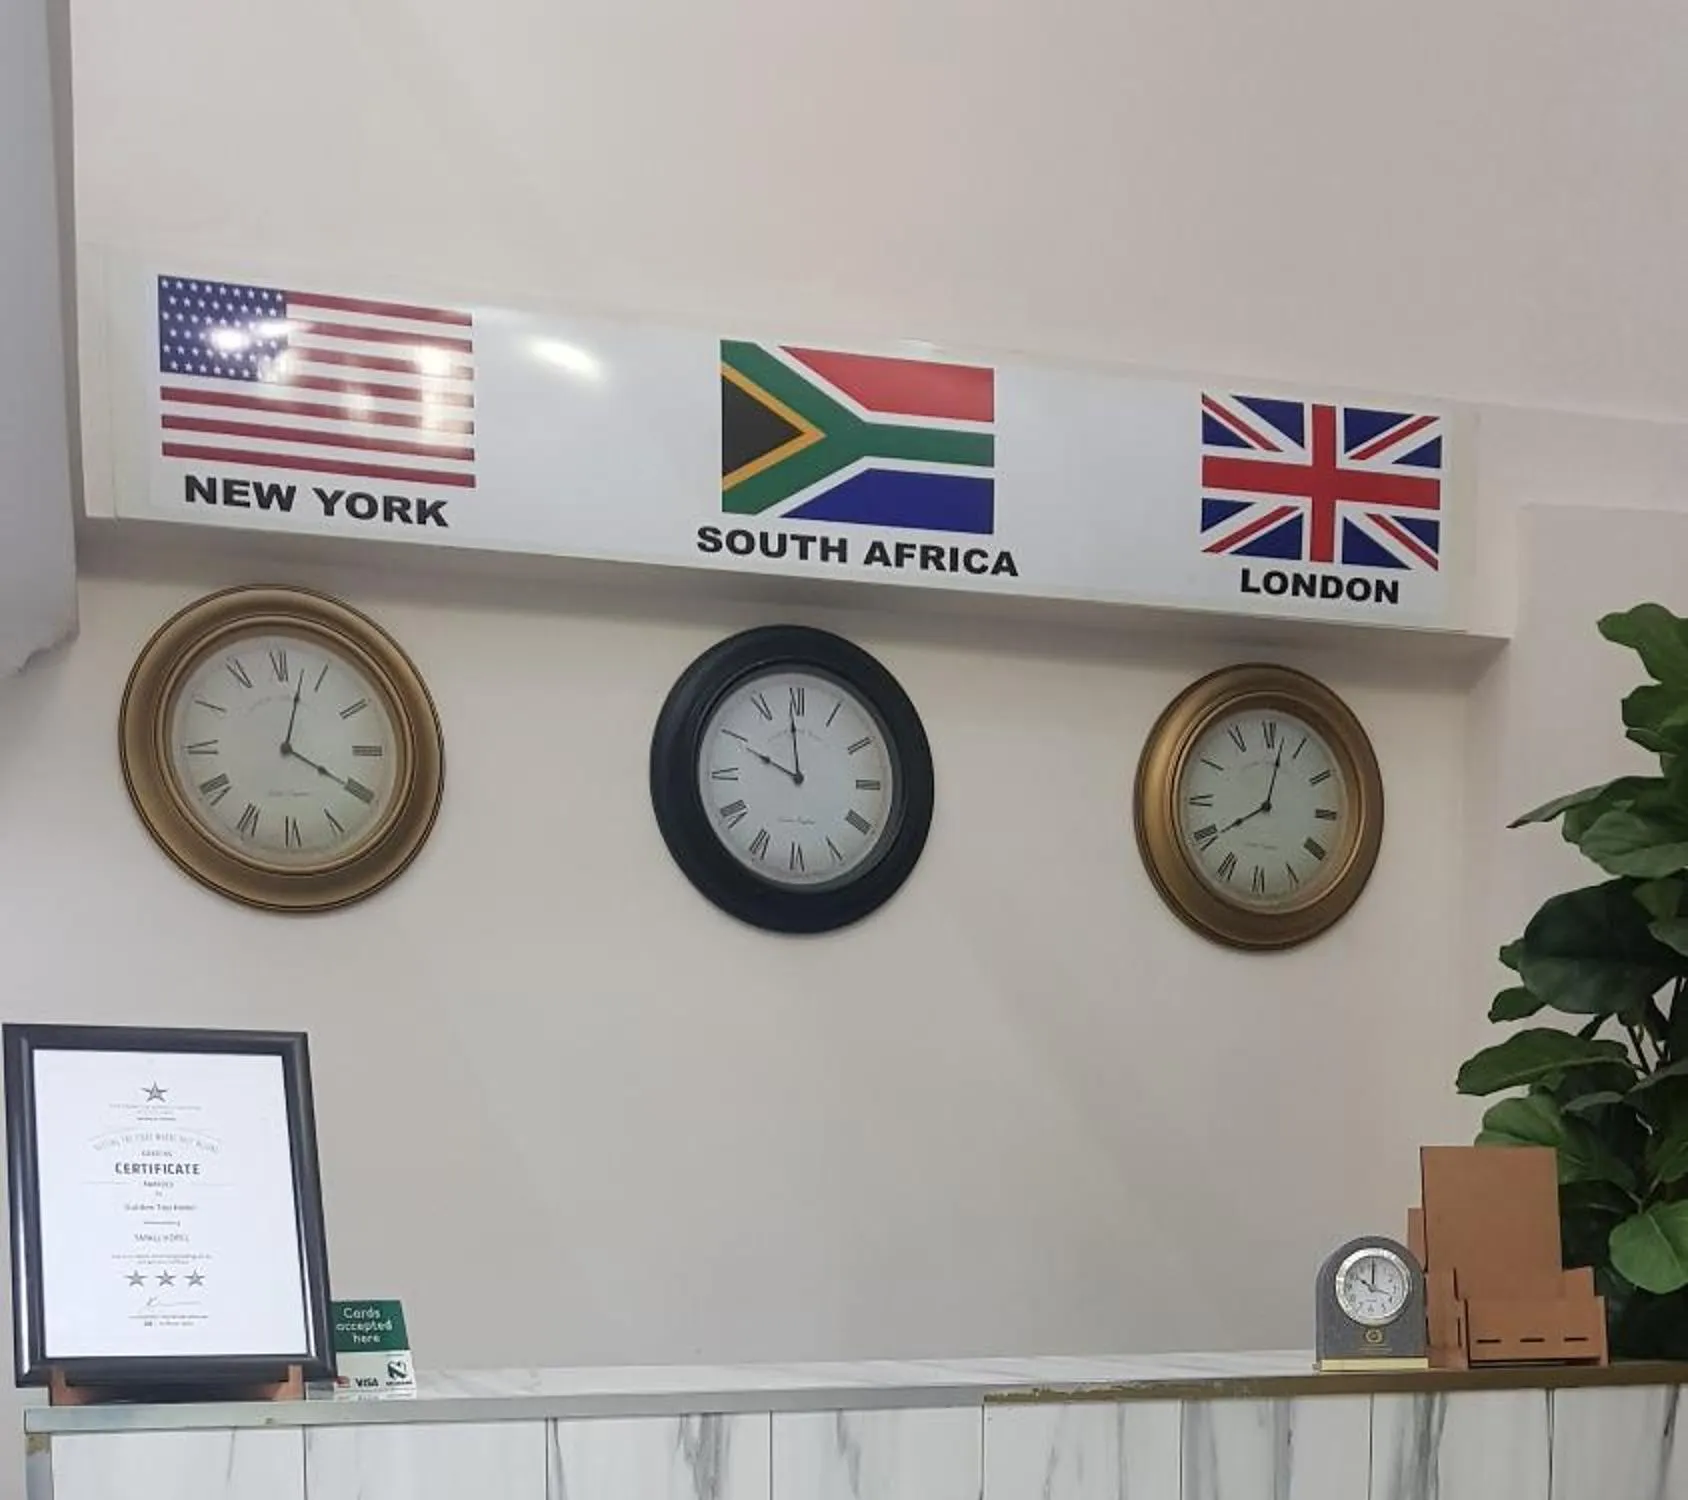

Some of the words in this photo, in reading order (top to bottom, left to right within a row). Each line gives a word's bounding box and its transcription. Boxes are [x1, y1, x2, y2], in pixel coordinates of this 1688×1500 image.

[184, 474, 297, 512] NEW
[312, 487, 449, 528] YORK
[696, 526, 848, 563] SOUTH
[863, 540, 1019, 577] AFRICA
[1240, 567, 1399, 605] LONDON
[114, 1162, 200, 1175] CERTIFICATE
[343, 1306, 380, 1319] Cards
[336, 1320, 393, 1333] accepted
[352, 1333, 381, 1344] here
[355, 1377, 379, 1387] VISA
